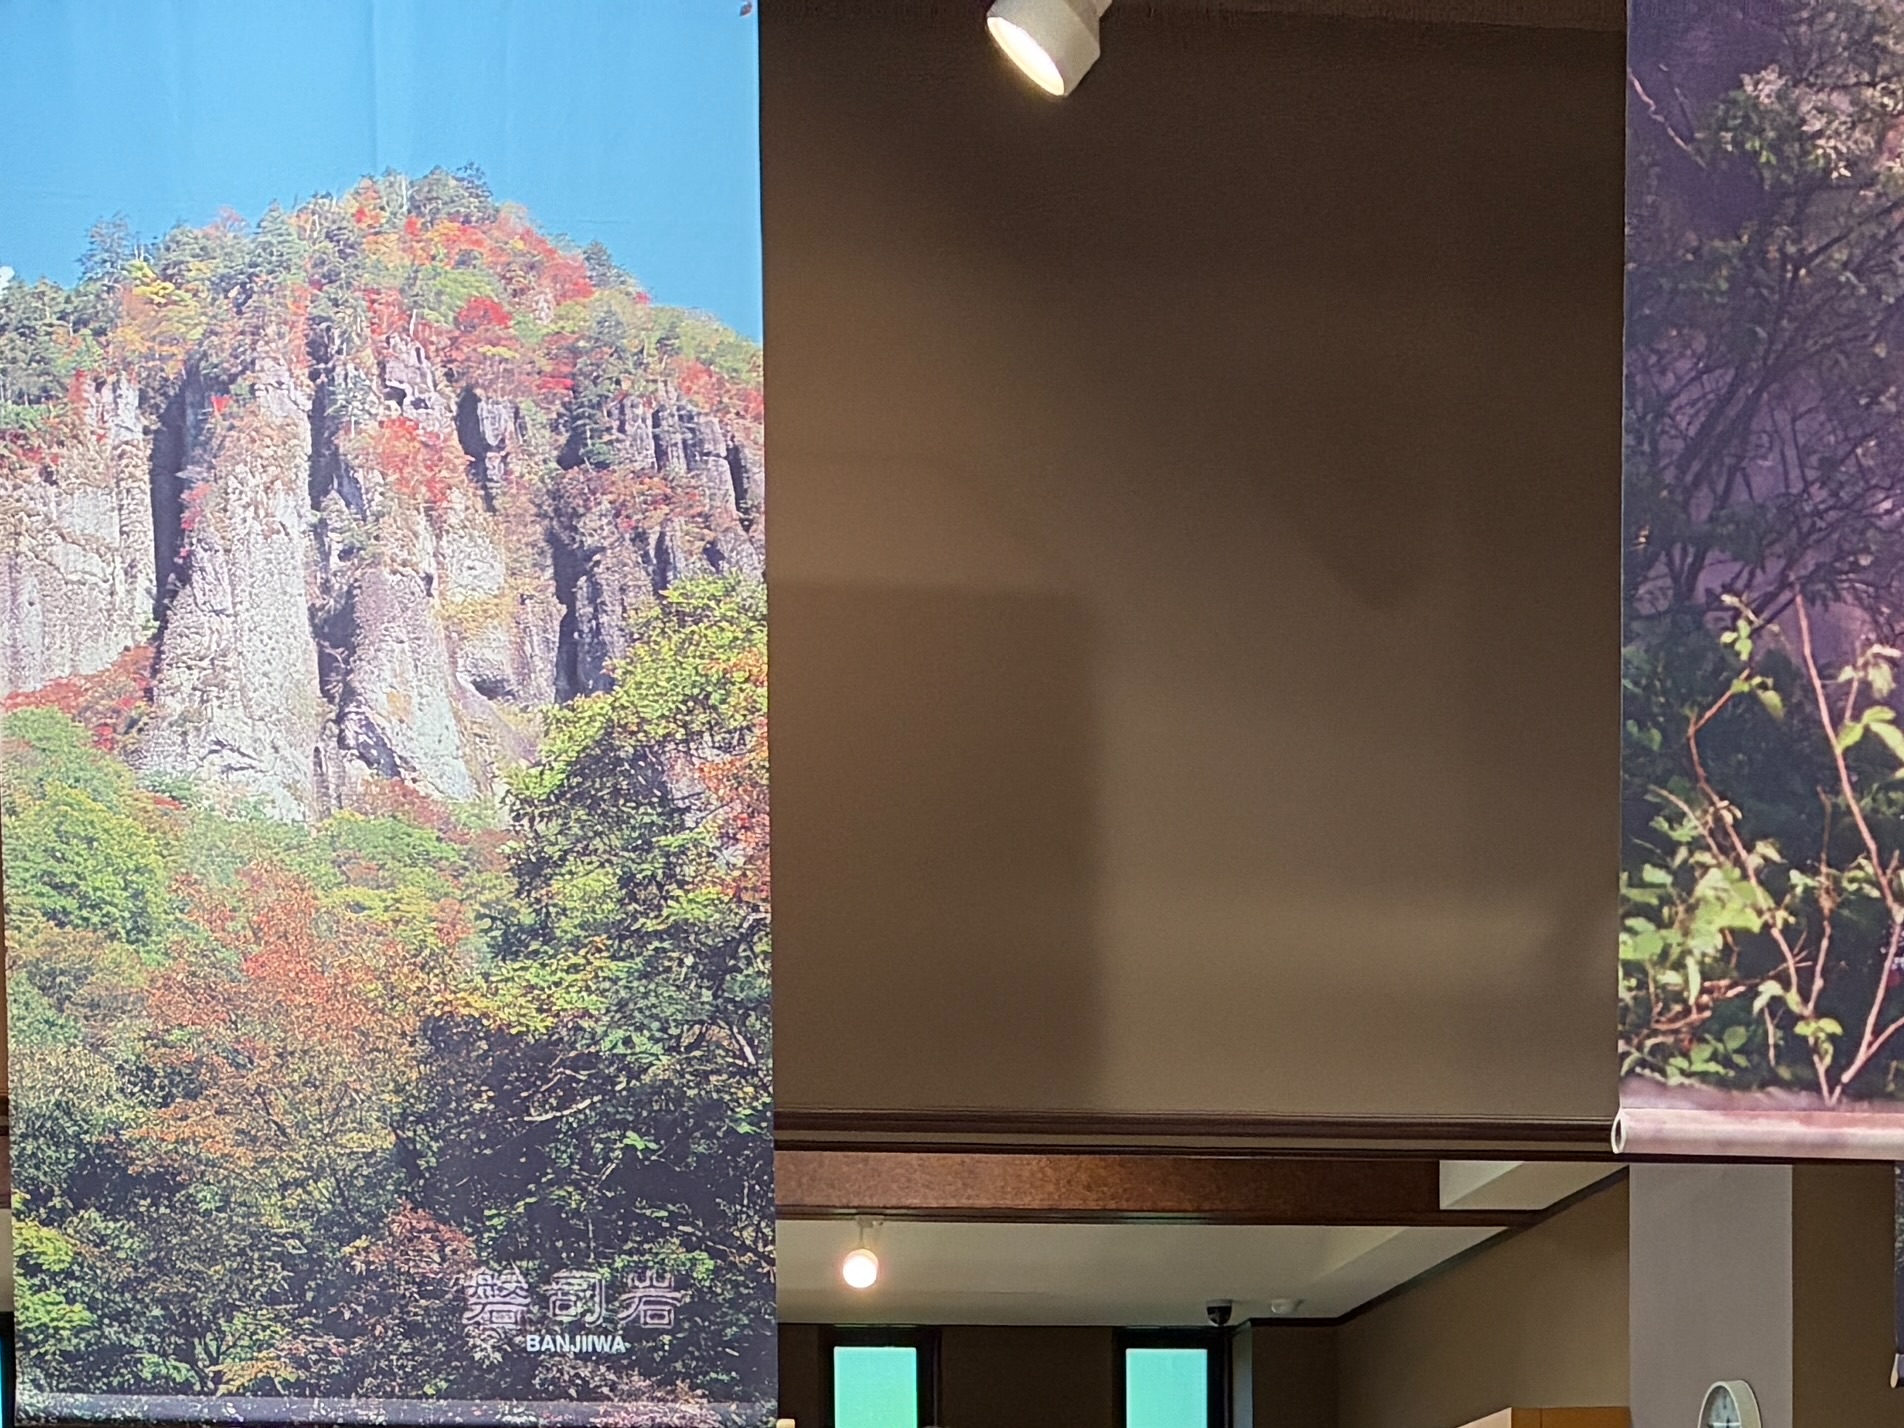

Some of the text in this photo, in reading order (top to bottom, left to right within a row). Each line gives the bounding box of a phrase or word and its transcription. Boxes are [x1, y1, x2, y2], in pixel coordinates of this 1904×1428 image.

[462, 1264, 685, 1330] 磐司岩
[525, 1334, 627, 1354] BANJIIWA
